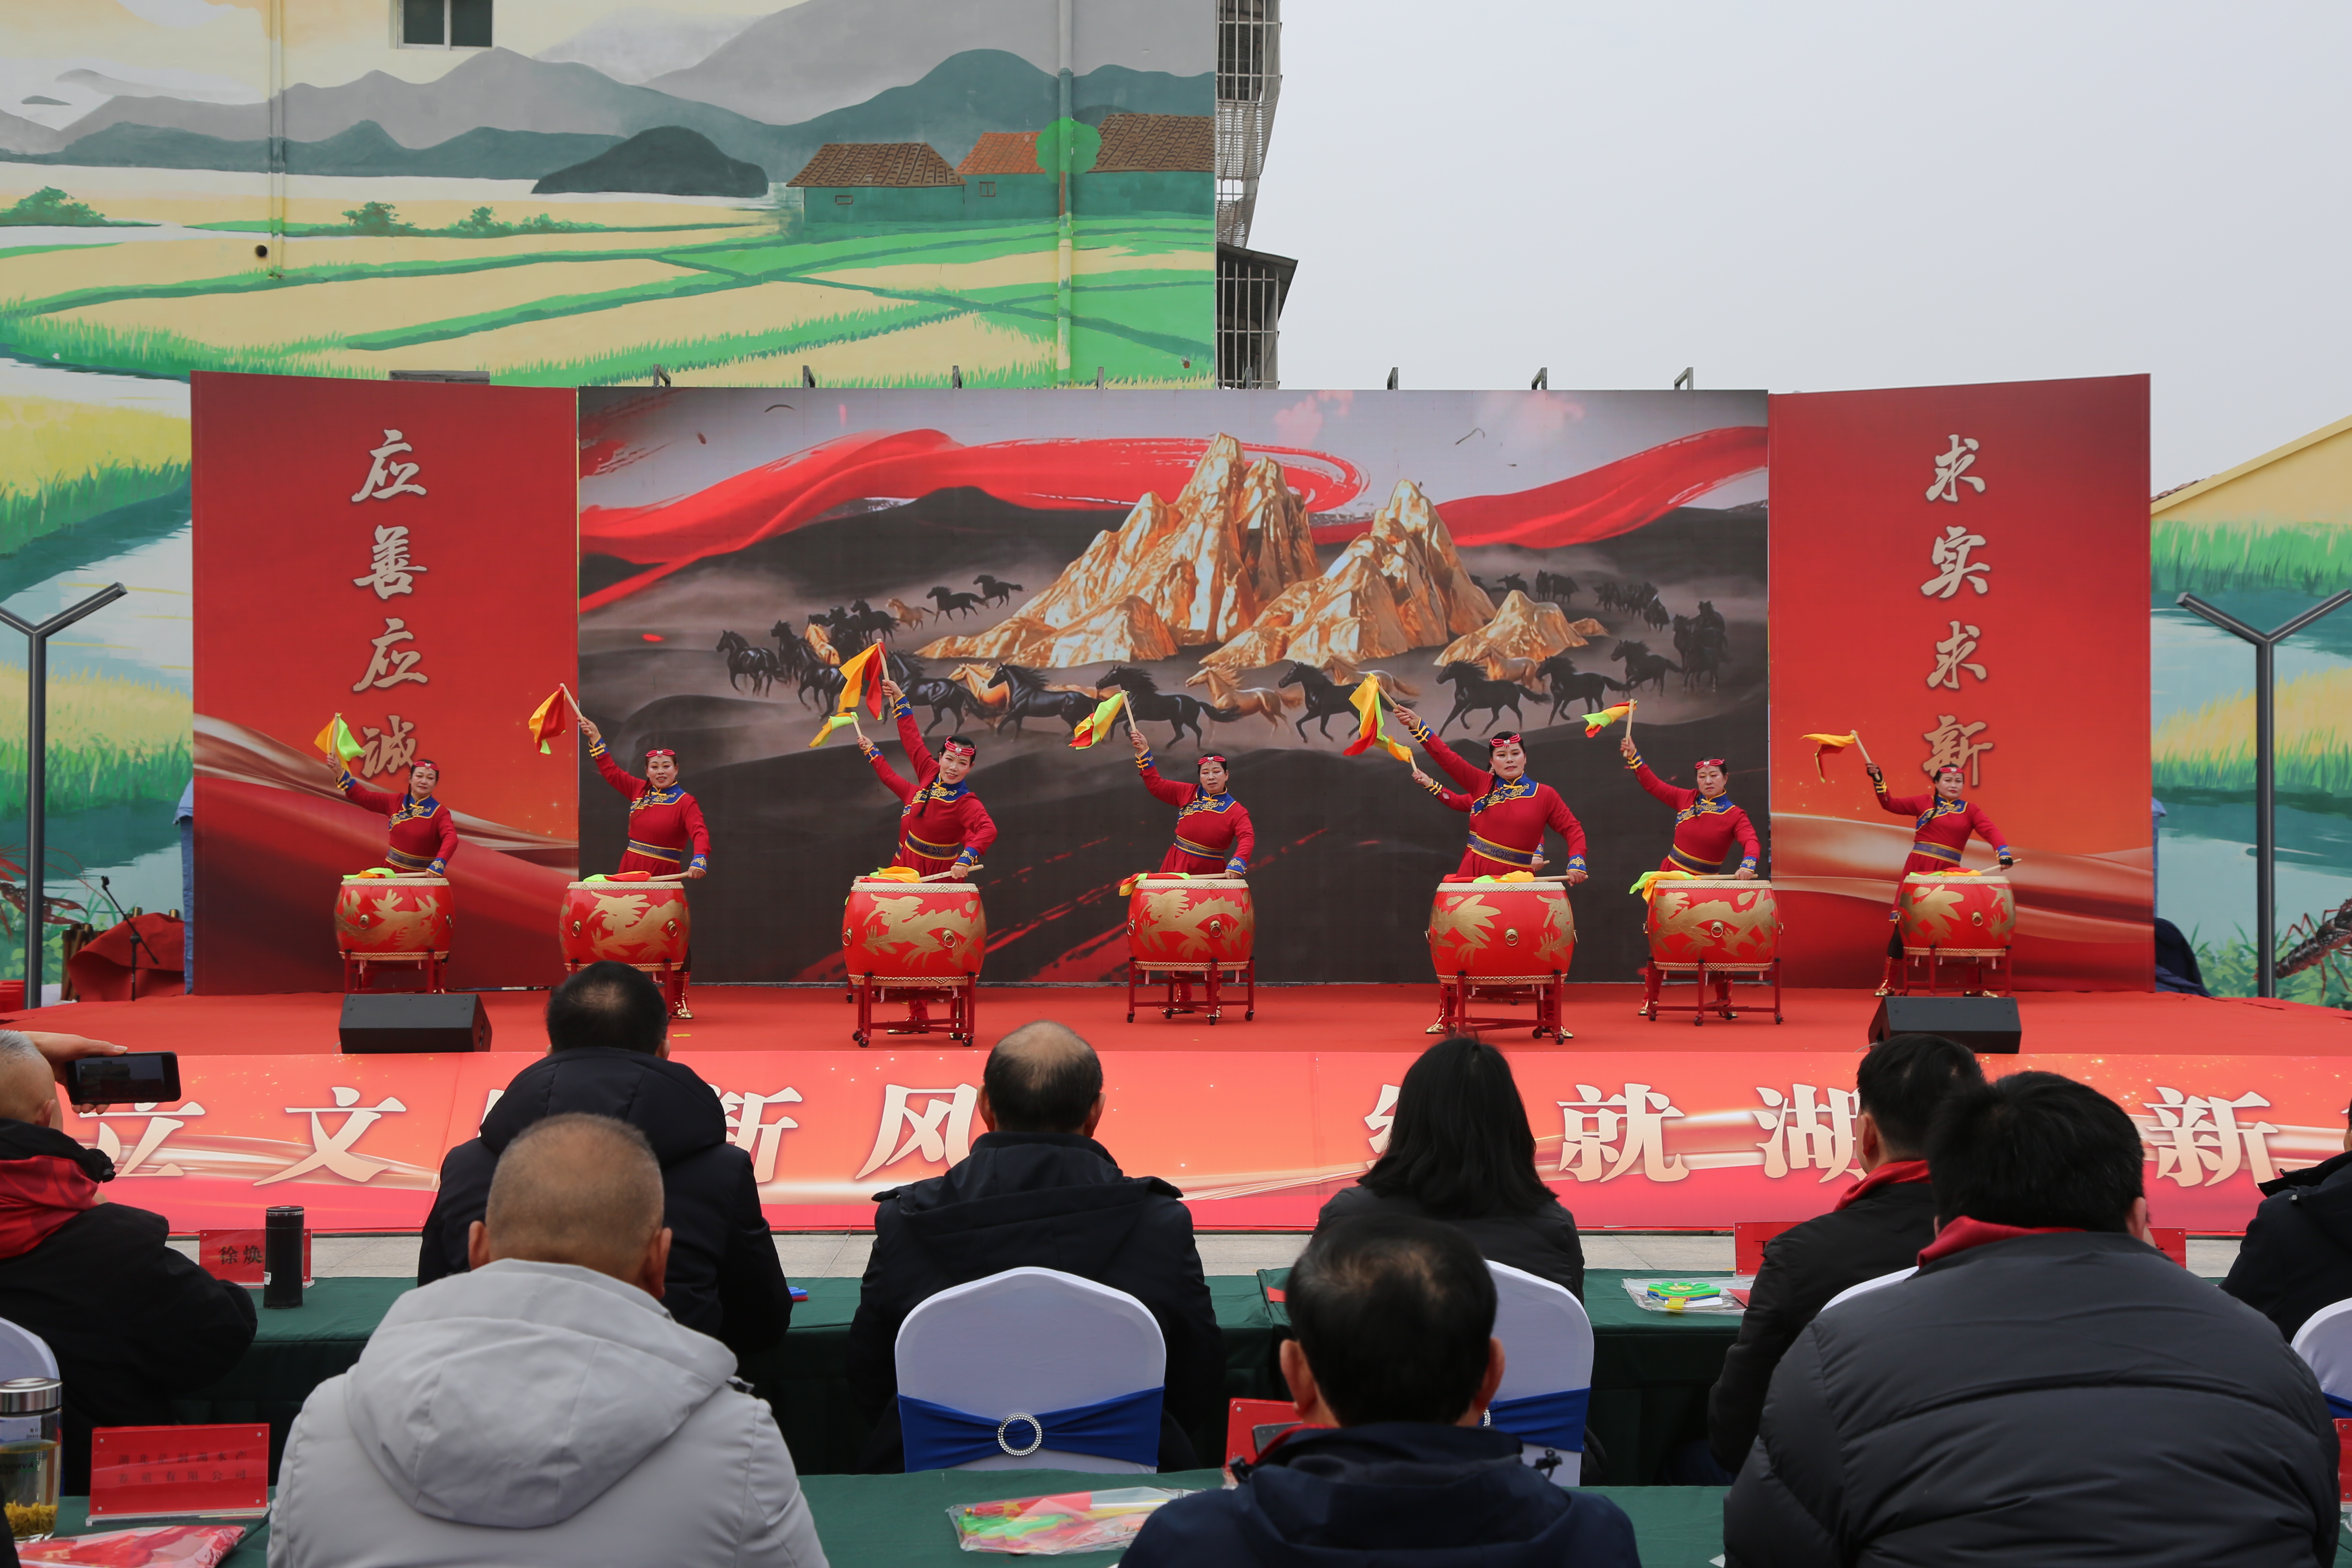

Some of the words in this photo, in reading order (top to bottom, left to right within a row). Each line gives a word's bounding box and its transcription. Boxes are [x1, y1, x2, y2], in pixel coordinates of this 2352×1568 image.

[352, 429, 427, 778] 应善应诚
[1920, 434, 1993, 786] 求实求新
[219, 1245, 263, 1265] 徐焕
